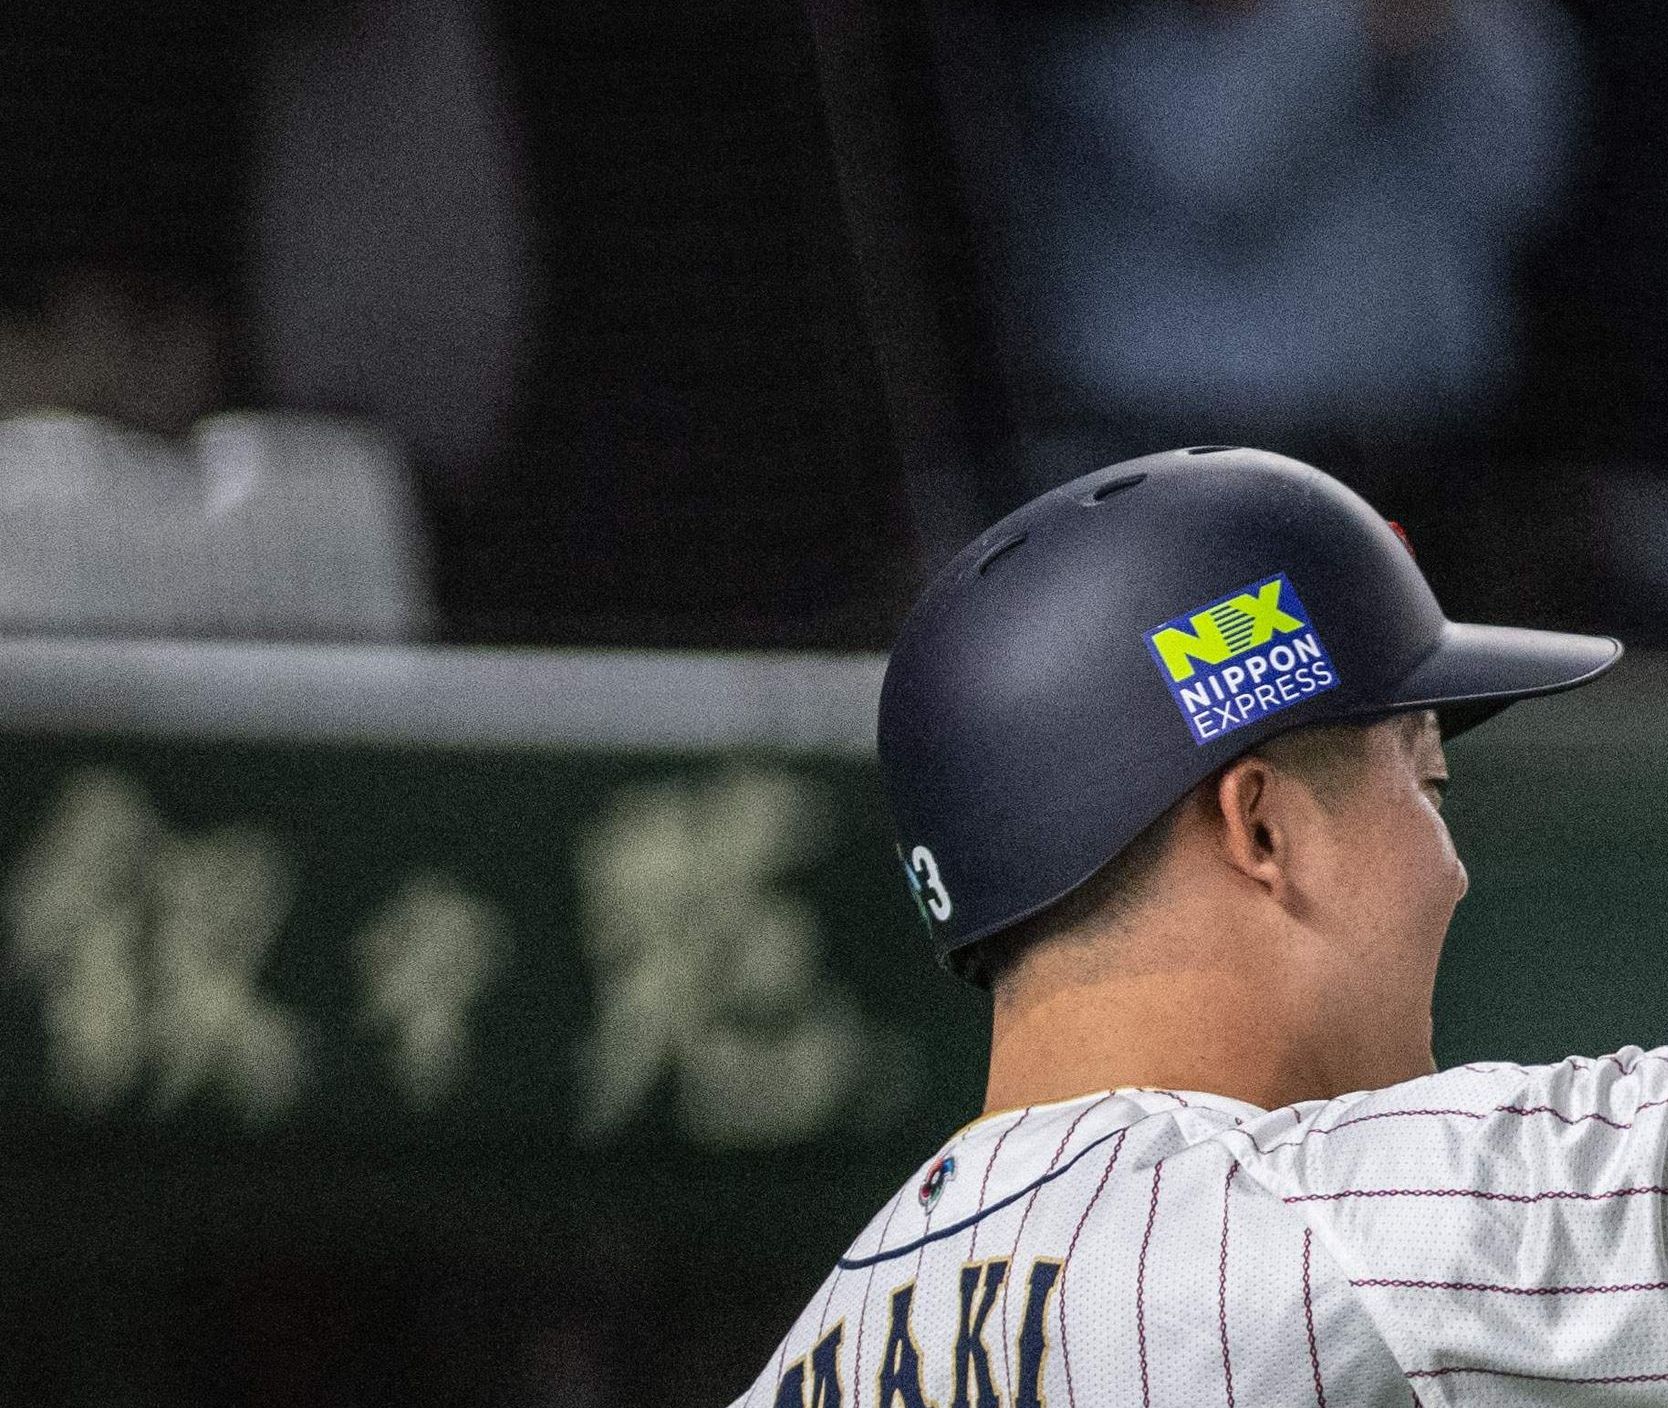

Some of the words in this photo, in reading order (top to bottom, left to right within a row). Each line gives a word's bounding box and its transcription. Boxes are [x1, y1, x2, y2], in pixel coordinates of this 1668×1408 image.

[1151, 578, 1306, 683] NX
[1179, 633, 1322, 714] NIPPON
[1192, 660, 1333, 739] EXPRESS
[911, 845, 952, 921] 3
